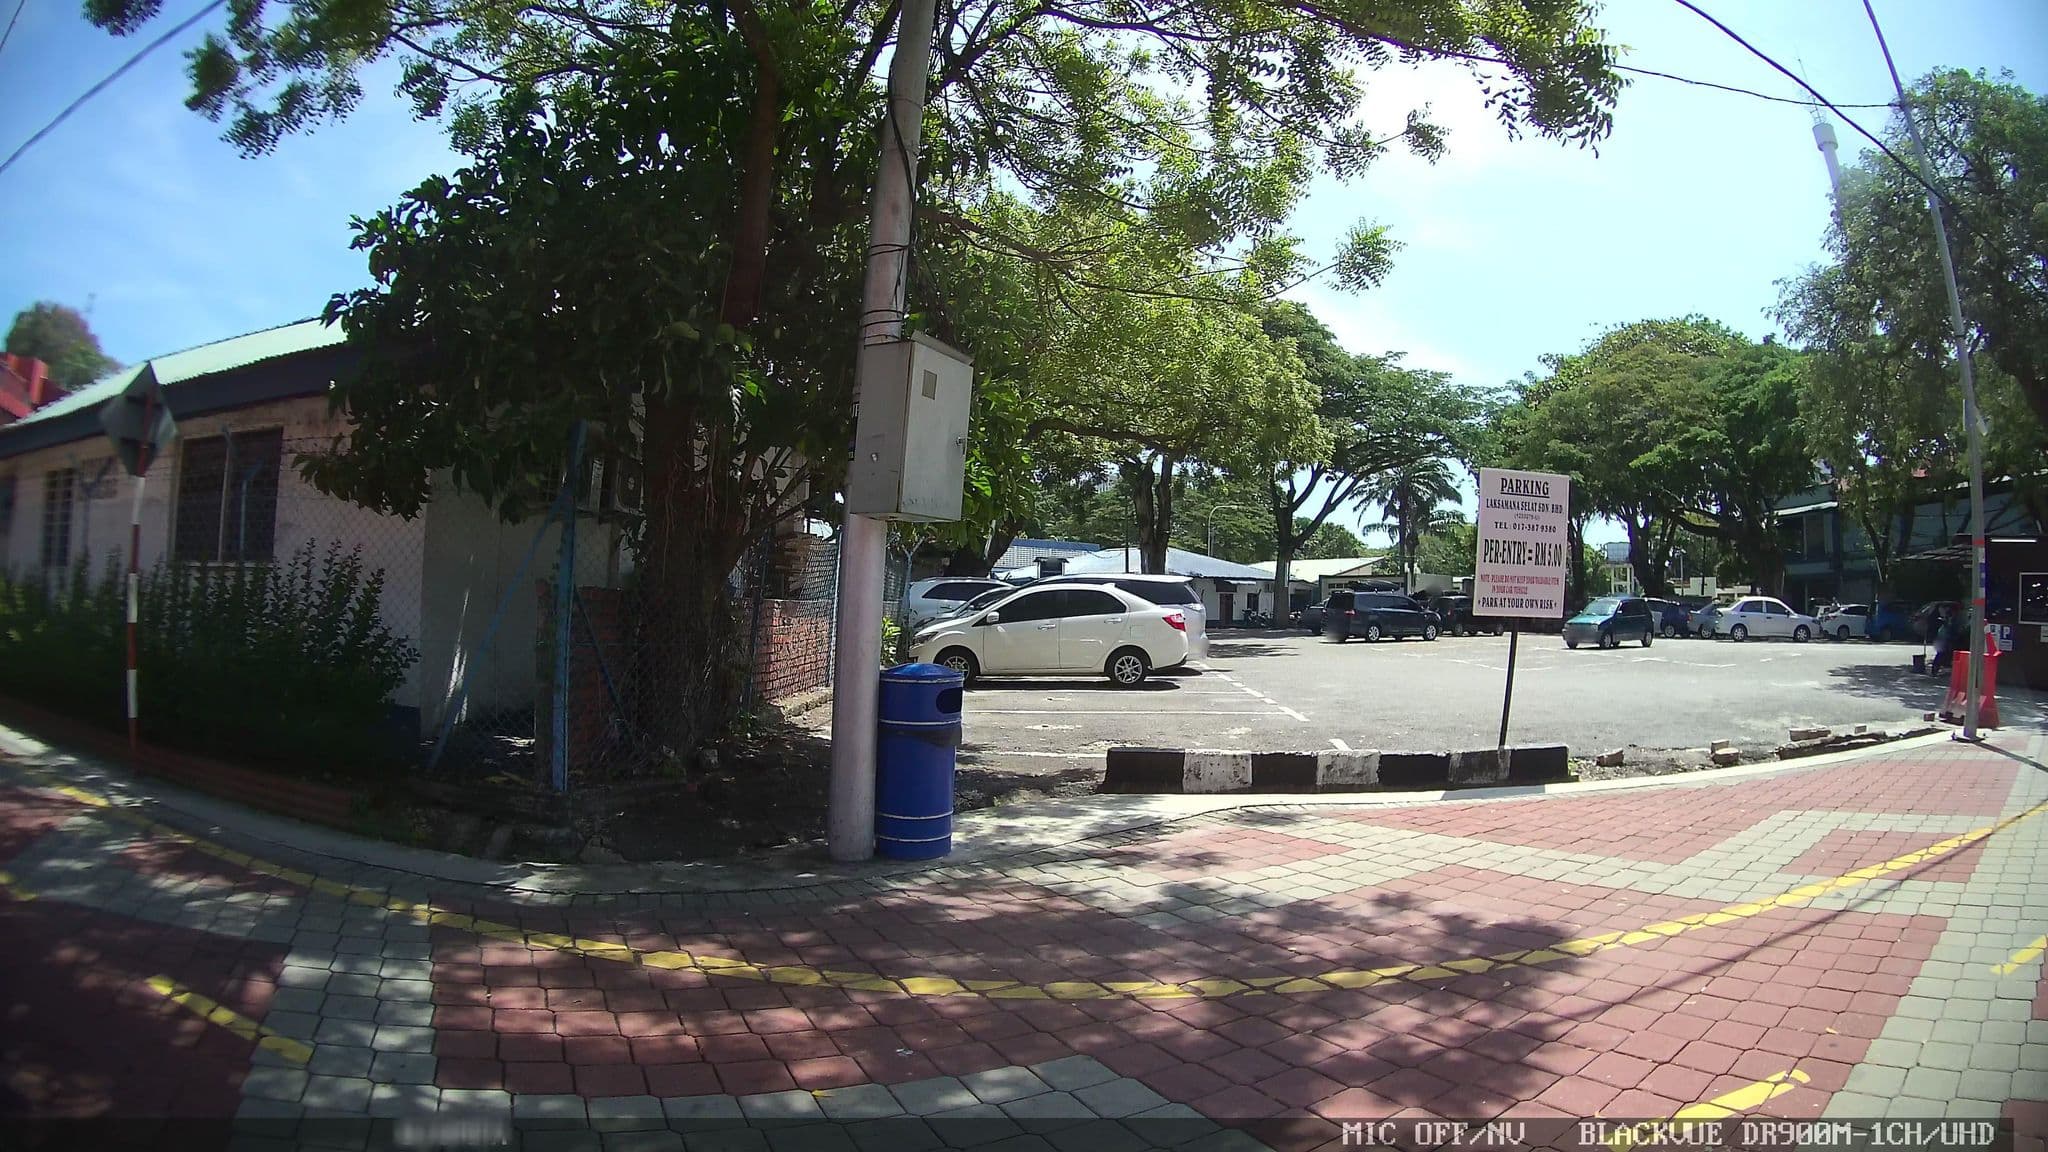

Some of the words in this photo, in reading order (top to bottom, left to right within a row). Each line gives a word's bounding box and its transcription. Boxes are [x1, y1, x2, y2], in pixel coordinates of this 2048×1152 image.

[1500, 477, 1549, 496] PARKING
[1486, 498, 1520, 511] LAKSAMANA
[1520, 501, 1537, 512] SELAT
[1483, 538, 1528, 566] PER-ENTRY
[1481, 597, 1498, 608] PARK
[1499, 597, 1507, 608] AT
[1507, 598, 1524, 609] YOUR
[1524, 598, 1539, 609] OWN
[1539, 599, 1554, 610] RISK
